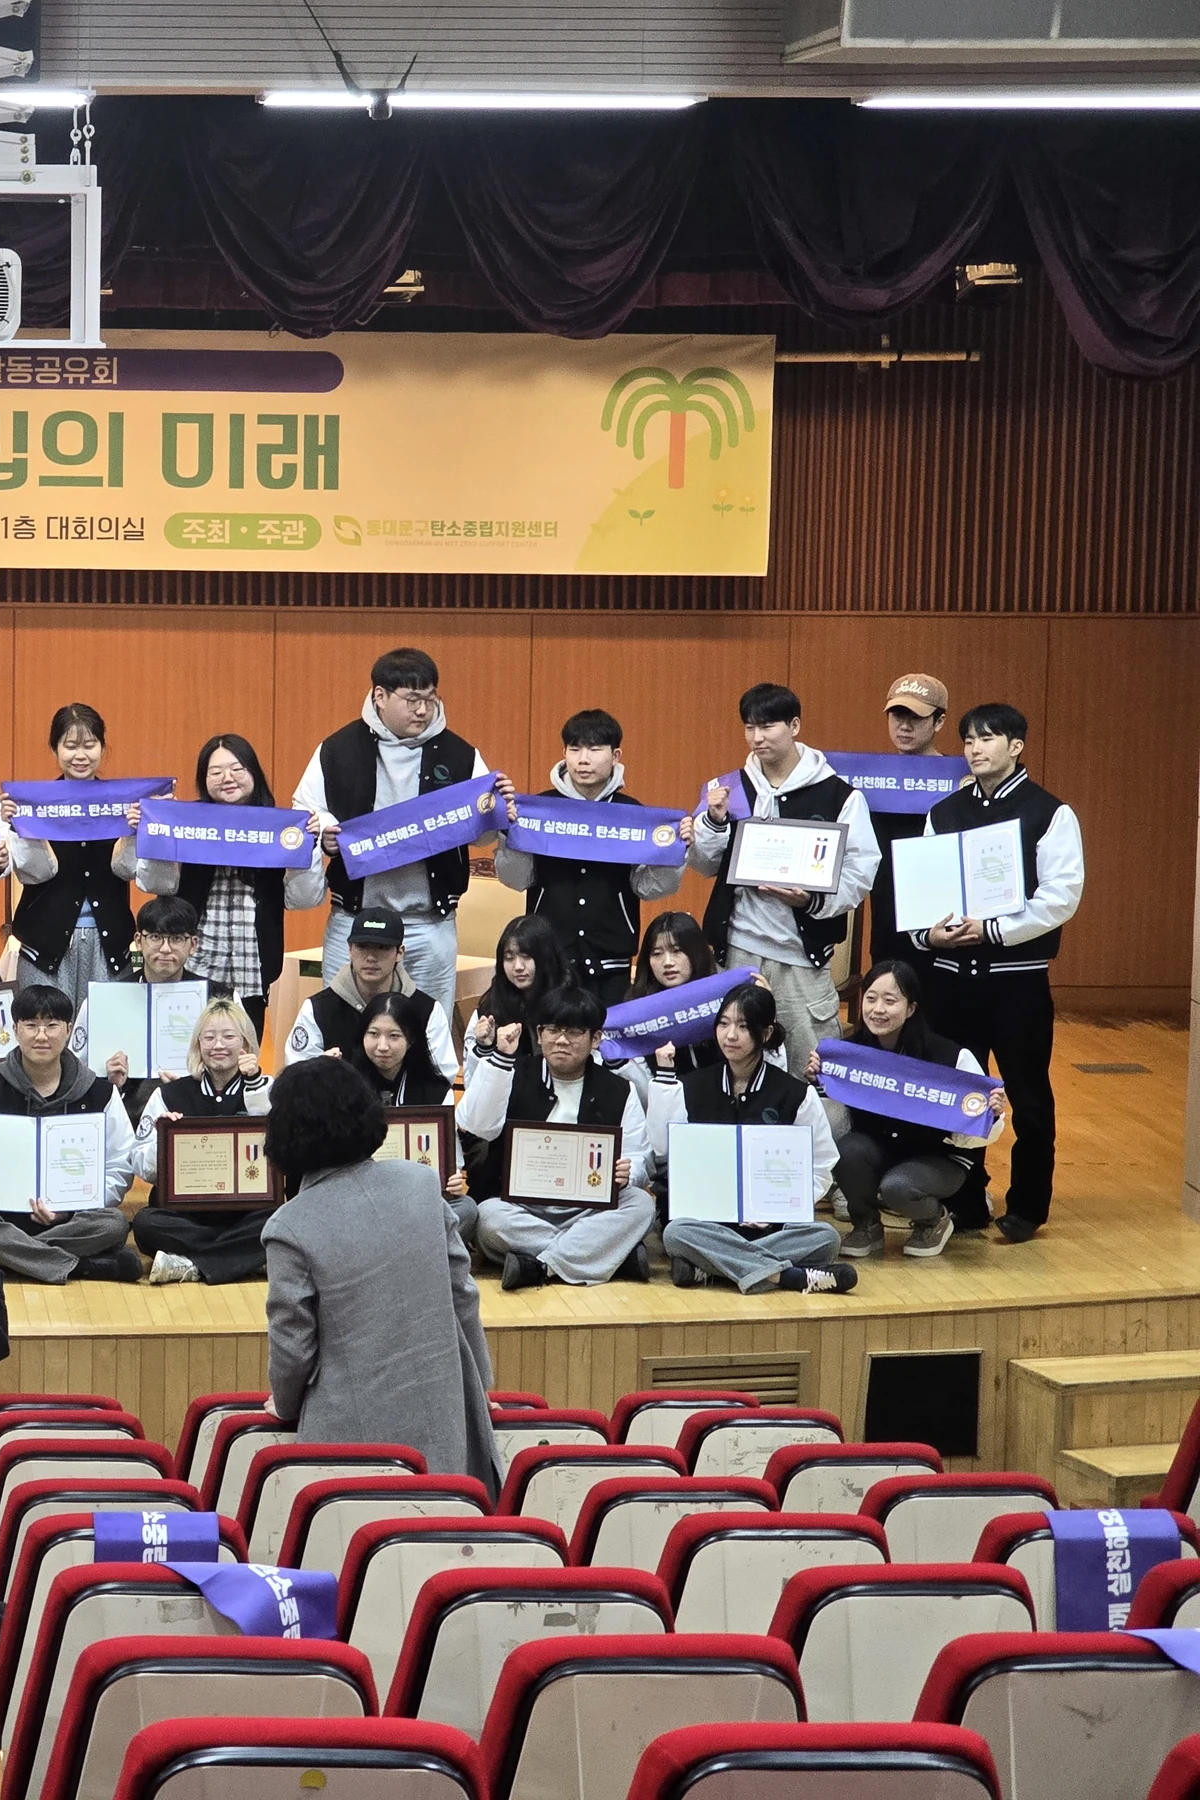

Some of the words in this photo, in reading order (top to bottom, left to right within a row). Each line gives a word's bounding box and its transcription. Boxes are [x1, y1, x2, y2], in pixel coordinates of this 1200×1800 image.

[161, 412, 341, 491] 미래
[0, 515, 37, 540] 1층
[46, 515, 146, 541] 대회의실
[181, 518, 230, 545] 주최
[256, 519, 307, 546] 주관
[365, 519, 559, 538] 동대문구탄소중립지원센터
[852, 775, 901, 790] 실천해요.
[903, 778, 953, 792] 탄소중립!
[35, 804, 86, 818] 실천해요.
[88, 803, 132, 817] 탄소중
[147, 822, 171, 836] 함께
[172, 824, 222, 842] 실천해요.
[224, 828, 274, 844] 탄소중립!
[348, 838, 375, 857] 함께
[374, 823, 424, 850] 실천해요.
[423, 804, 473, 832] 탄소중립!
[516, 816, 541, 832] 함께
[543, 820, 593, 838] 실천해요.
[595, 824, 647, 842] 탄소중립!
[623, 1015, 674, 1038] 실천해요.
[820, 1060, 847, 1079] 함께
[849, 1067, 900, 1094] 실천해요.
[903, 1082, 957, 1108] 탄소중립!
[1097, 1508, 1132, 1597] 실천해요
